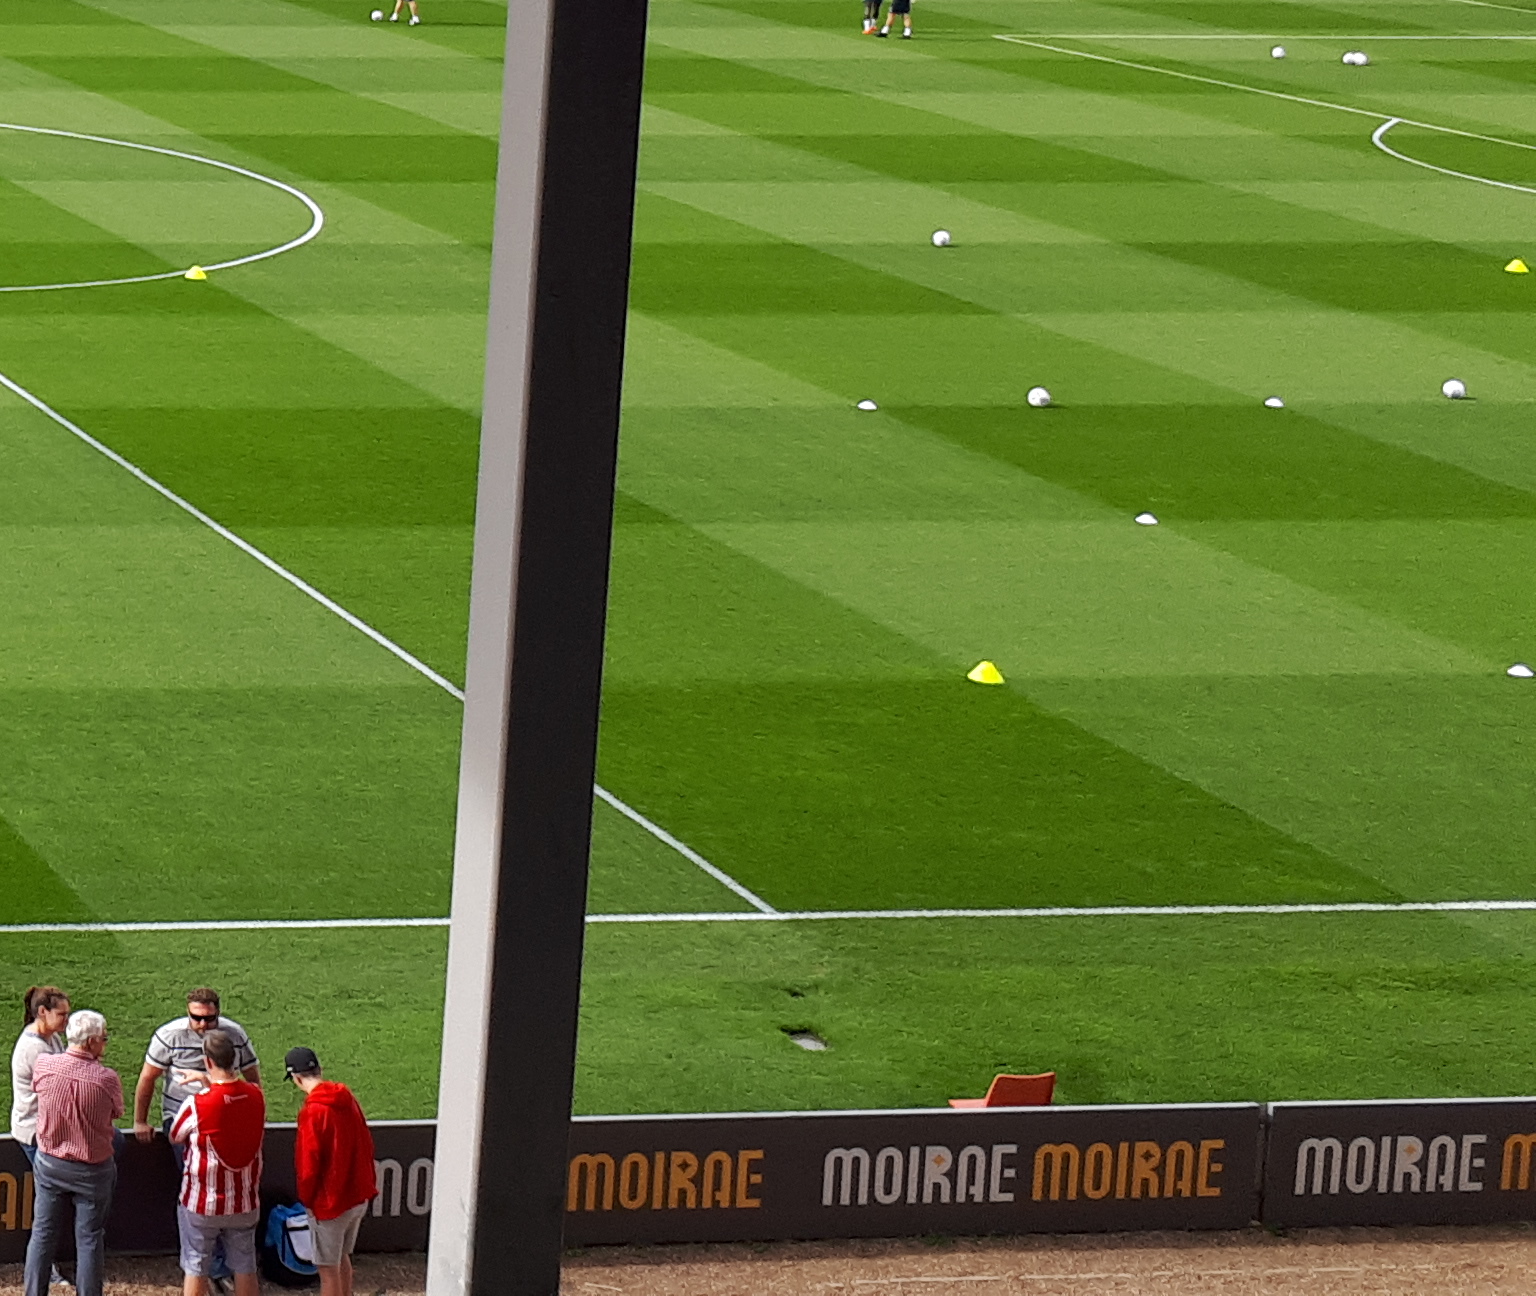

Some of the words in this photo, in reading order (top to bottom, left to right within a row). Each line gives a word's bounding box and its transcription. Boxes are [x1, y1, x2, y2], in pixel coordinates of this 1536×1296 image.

[567, 1148, 764, 1212] MOIRAE
[821, 1143, 1019, 1206] MOIRAE
[1031, 1138, 1226, 1202] MOIRAE
[1293, 1133, 1488, 1196] MOIRAE
